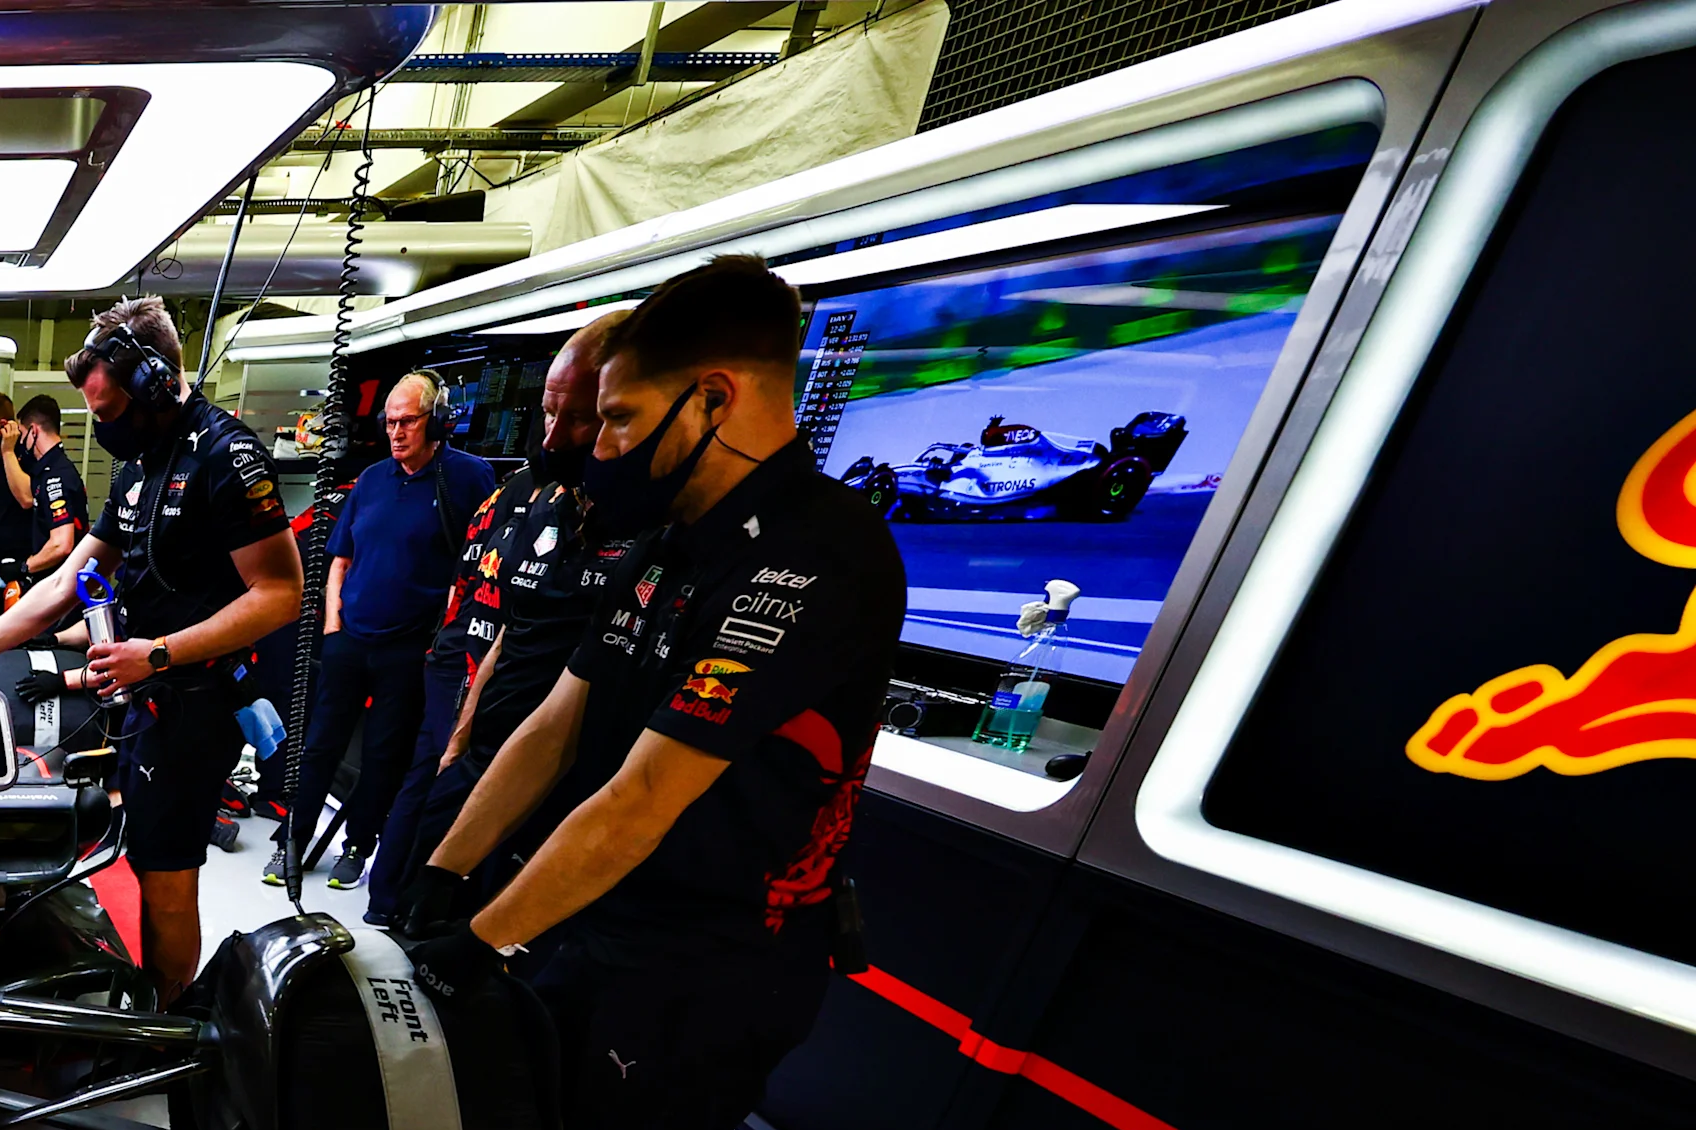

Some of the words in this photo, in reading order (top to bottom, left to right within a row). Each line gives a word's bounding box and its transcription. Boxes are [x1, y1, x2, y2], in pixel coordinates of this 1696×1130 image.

[356, 380, 380, 416] 1
[162, 505, 181, 516] Tezos
[750, 567, 818, 589] telcel
[732, 592, 804, 623] citrix
[713, 642, 748, 655] Enterprise
[716, 635, 744, 647] Hewlett
[744, 641, 775, 654] Packard
[366, 977, 399, 1023] Left
[389, 979, 428, 1042] Front
